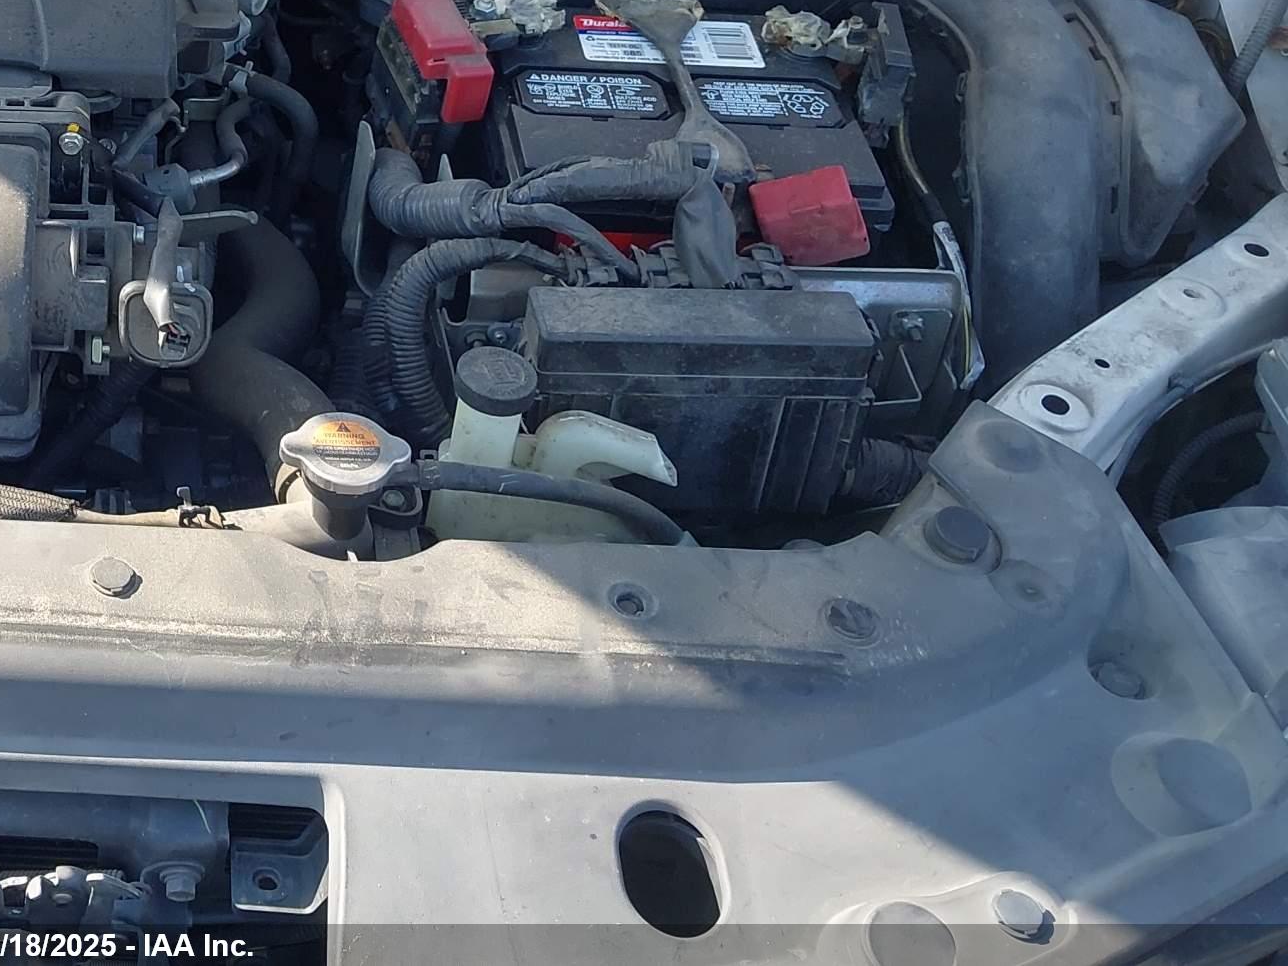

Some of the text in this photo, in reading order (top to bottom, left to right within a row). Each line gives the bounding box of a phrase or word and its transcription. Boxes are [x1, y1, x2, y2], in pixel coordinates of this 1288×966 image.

[580, 18, 632, 28] Durala
[541, 74, 588, 83] DANGER
[599, 76, 642, 85] POISON
